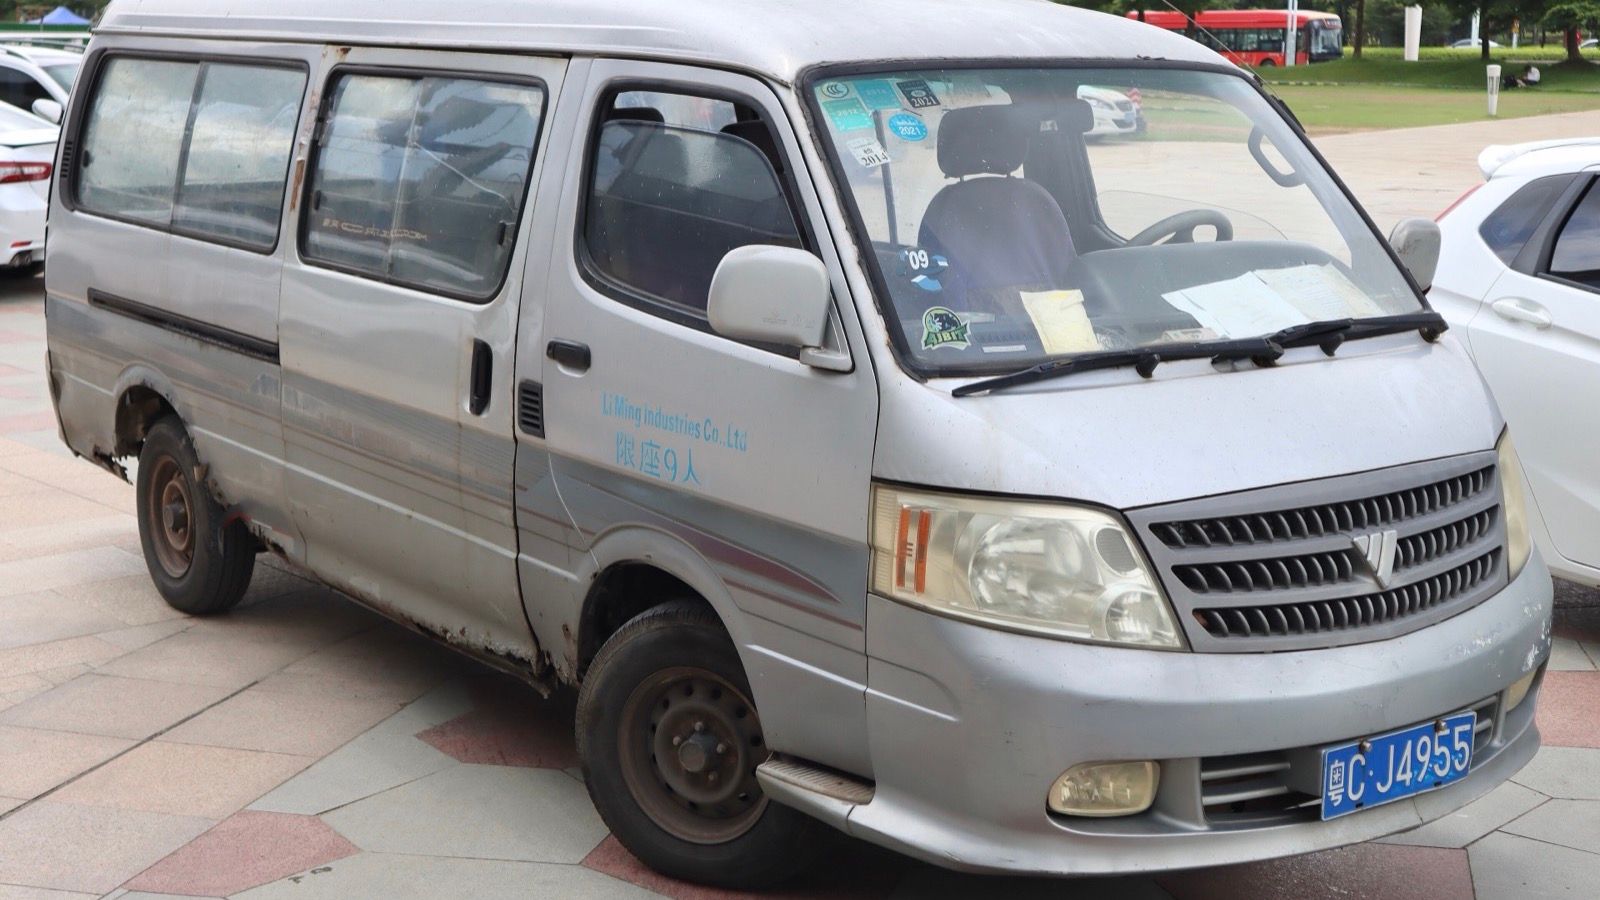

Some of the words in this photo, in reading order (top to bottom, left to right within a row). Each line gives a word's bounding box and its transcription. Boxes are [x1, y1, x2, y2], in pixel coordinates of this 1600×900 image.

[911, 95, 937, 107] 2021
[898, 126, 922, 136] 2021
[861, 152, 888, 167] 2014
[614, 394, 642, 428] Ming
[615, 431, 701, 485] 限座9人
